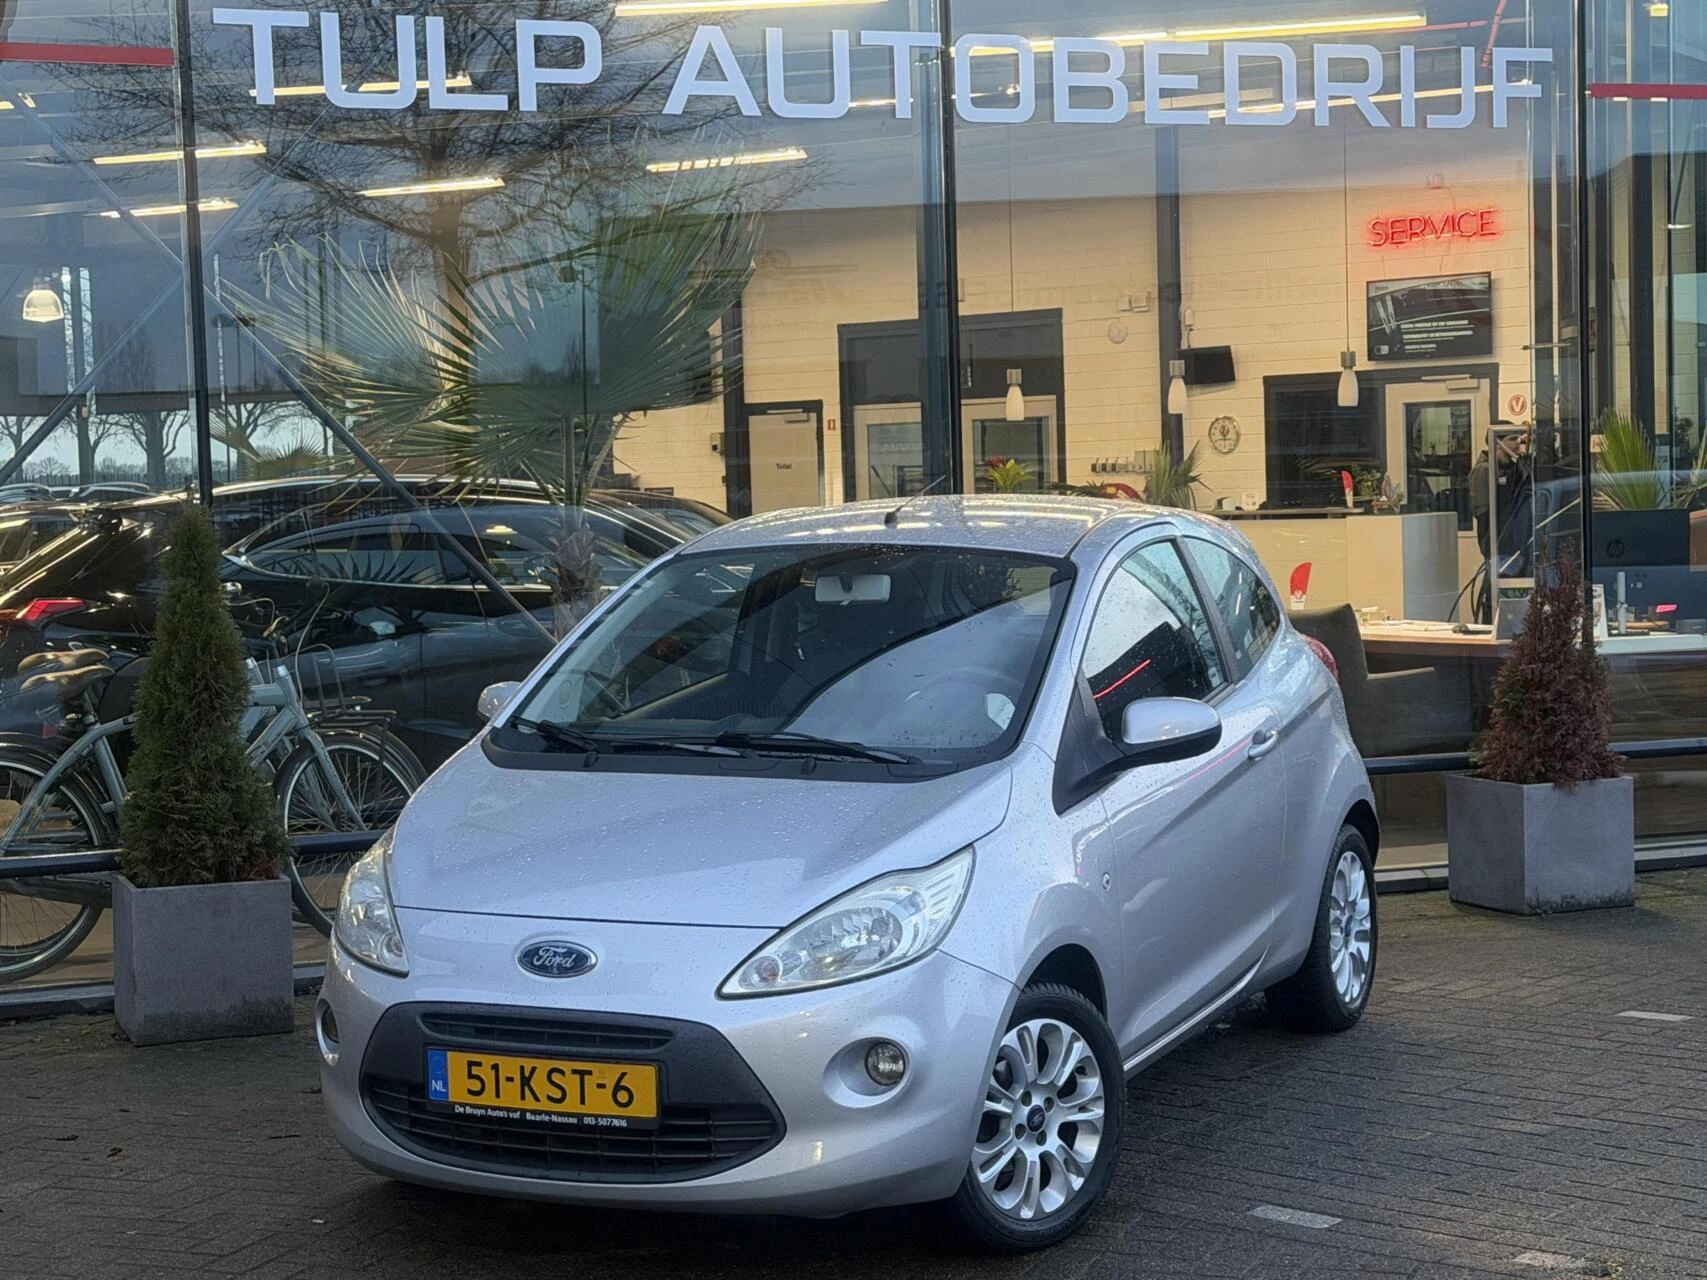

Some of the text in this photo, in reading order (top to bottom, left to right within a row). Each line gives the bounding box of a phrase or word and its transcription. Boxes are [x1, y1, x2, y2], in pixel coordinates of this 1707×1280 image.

[212, 8, 1553, 129] TULP AUTOBEDRIJF
[1370, 209, 1498, 247] SERVICE
[532, 946, 577, 968] Ford
[431, 1079, 447, 1092] NL
[466, 1059, 635, 1109] 51-KST-6
[454, 1104, 465, 1114] De
[465, 1106, 486, 1117] Bruyn
[508, 1111, 521, 1119] vof
[525, 1112, 578, 1124] Baarle-Nassau
[583, 1117, 628, 1128] 013-5077616
